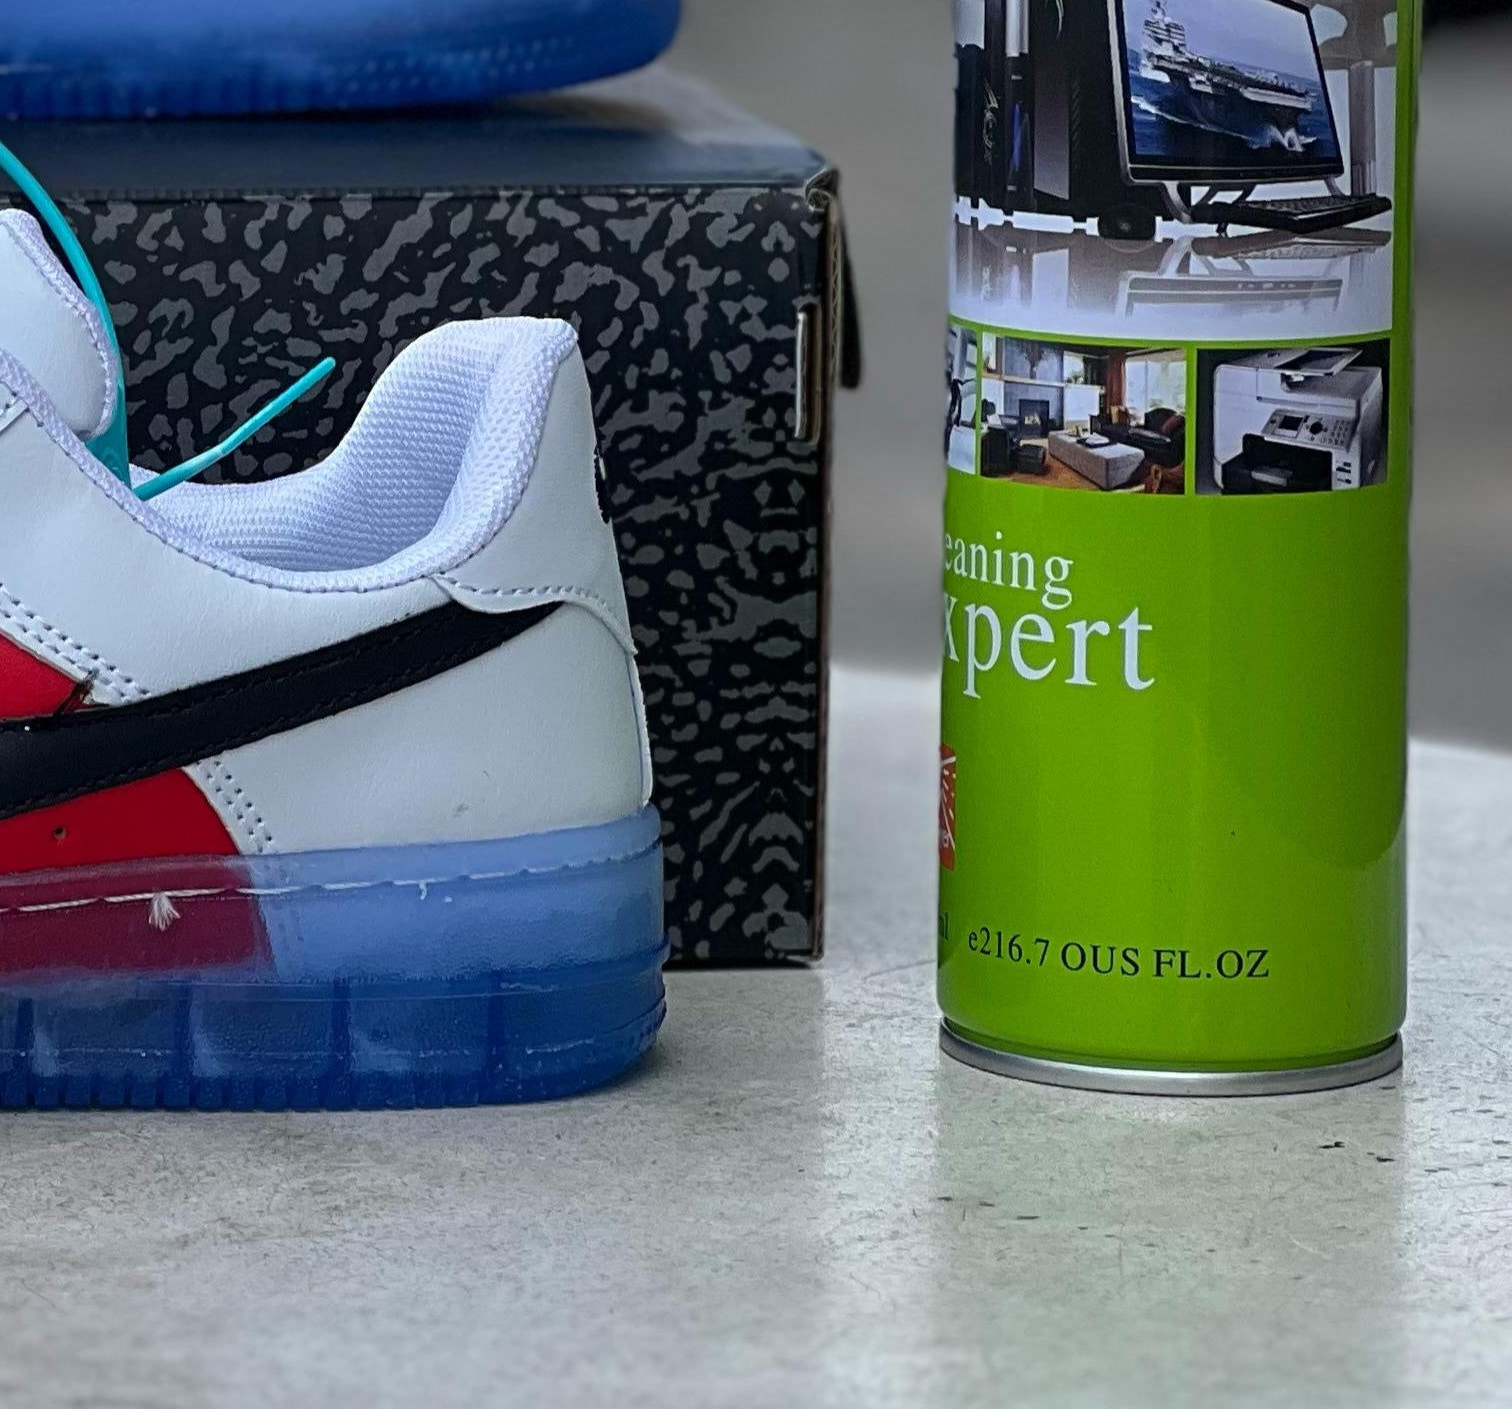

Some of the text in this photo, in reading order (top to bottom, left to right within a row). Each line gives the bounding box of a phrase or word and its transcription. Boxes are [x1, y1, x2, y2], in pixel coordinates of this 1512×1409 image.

[968, 926, 1050, 967] e216.7
[1061, 941, 1140, 977] OUS
[1152, 948, 1270, 979] FL.OZ
